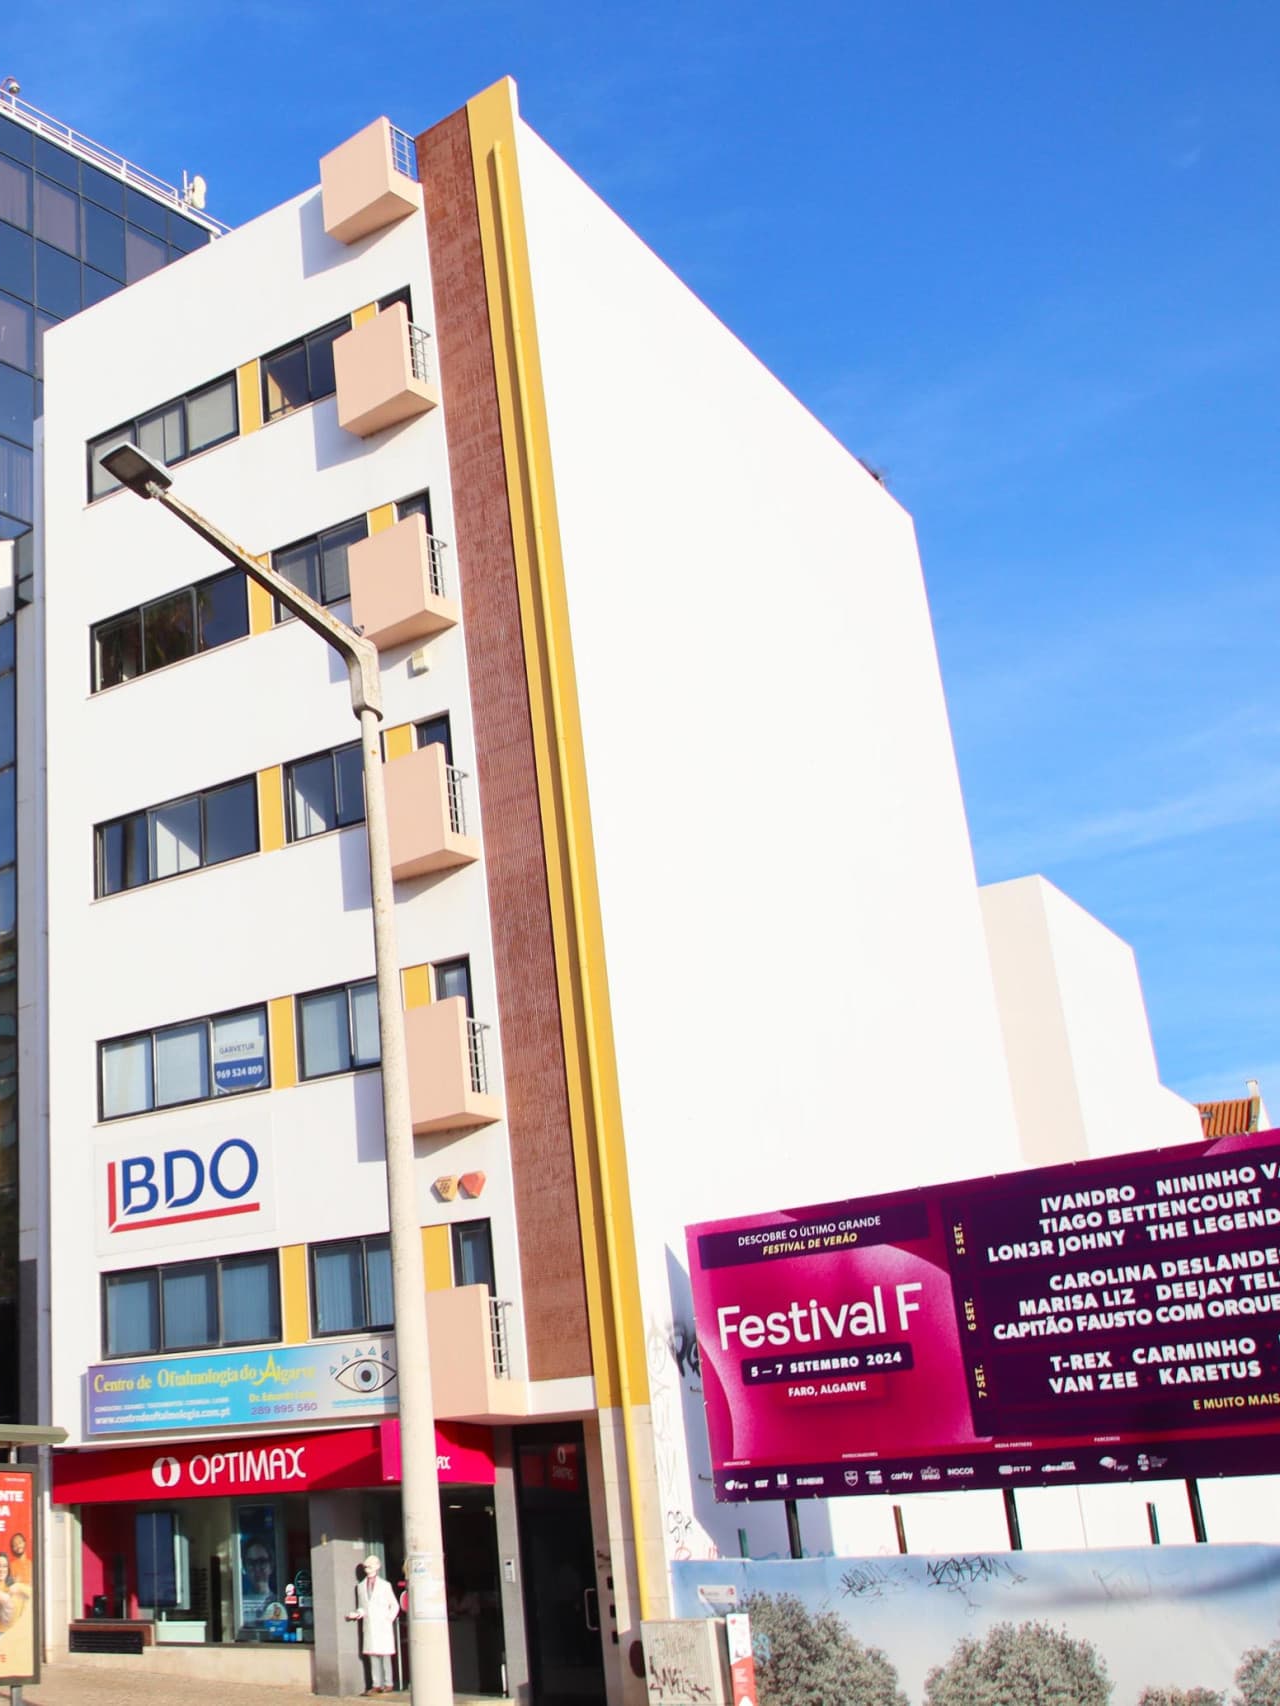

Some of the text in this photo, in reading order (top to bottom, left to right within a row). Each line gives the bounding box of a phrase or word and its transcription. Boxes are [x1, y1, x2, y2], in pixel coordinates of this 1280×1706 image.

[122, 1138, 259, 1216] BDO
[1041, 1185, 1135, 1213] IVANDRO
[1156, 1166, 1256, 1196] NININHO
[1039, 1187, 1262, 1234] TIAGO BETTENCOURT
[738, 1216, 881, 1247] DESCOBRE O ÚLTIMO GRANDE
[763, 1232, 858, 1255] FESTIVAL DE VERÃO
[953, 1222, 966, 1255] 5 SET.
[987, 1240, 1054, 1263] LON3R
[1058, 1229, 1125, 1257] JOHNY
[1146, 1221, 1189, 1241] THE
[1049, 1248, 1280, 1290] CAROLINA DESLANDE
[1019, 1270, 1280, 1316] MARISA LIZ DEEJAY TEL
[717, 1286, 886, 1351] Festival
[896, 1282, 923, 1331] F
[964, 1298, 977, 1331] 6 SET.
[993, 1316, 1074, 1340] CAPITÃO
[1076, 1308, 1153, 1332] FAUSTO
[1156, 1302, 1205, 1323] COM
[751, 1366, 759, 1377] 5
[776, 1364, 783, 1375] 7
[789, 1356, 859, 1373] SETEMBRO
[866, 1351, 902, 1367] 2024
[1050, 1337, 1257, 1372] T-REX CARMINHO
[94, 1374, 134, 1393] Centro
[136, 1374, 152, 1389] de
[788, 1381, 867, 1398] FARO, ALGARVE
[974, 1364, 987, 1399] 7 SET.
[1048, 1360, 1262, 1394] VAN ZEE KARETUS
[1193, 1400, 1201, 1410] E
[1203, 1396, 1245, 1410] MUITO
[189, 1446, 307, 1486] OPTIMAX
